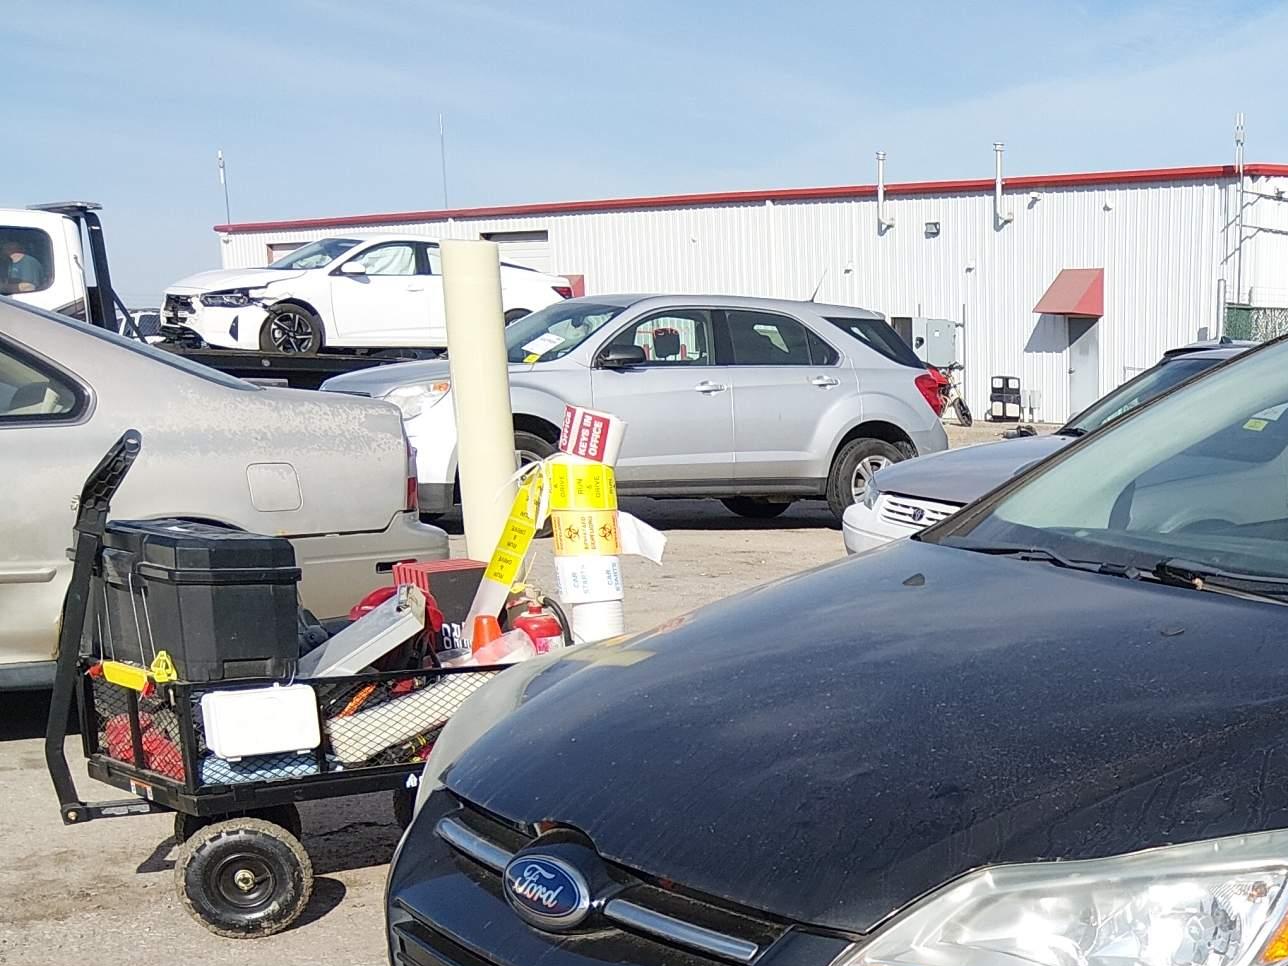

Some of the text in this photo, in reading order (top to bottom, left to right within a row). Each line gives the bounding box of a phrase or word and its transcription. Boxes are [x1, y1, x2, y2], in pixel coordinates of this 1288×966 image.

[561, 411, 572, 446] OFFICE
[578, 414, 593, 456] KEYS IN
[588, 420, 603, 457] OFFICE
[576, 478, 585, 495] RUN
[606, 569, 614, 586] CAR
[513, 864, 564, 908] Ford
